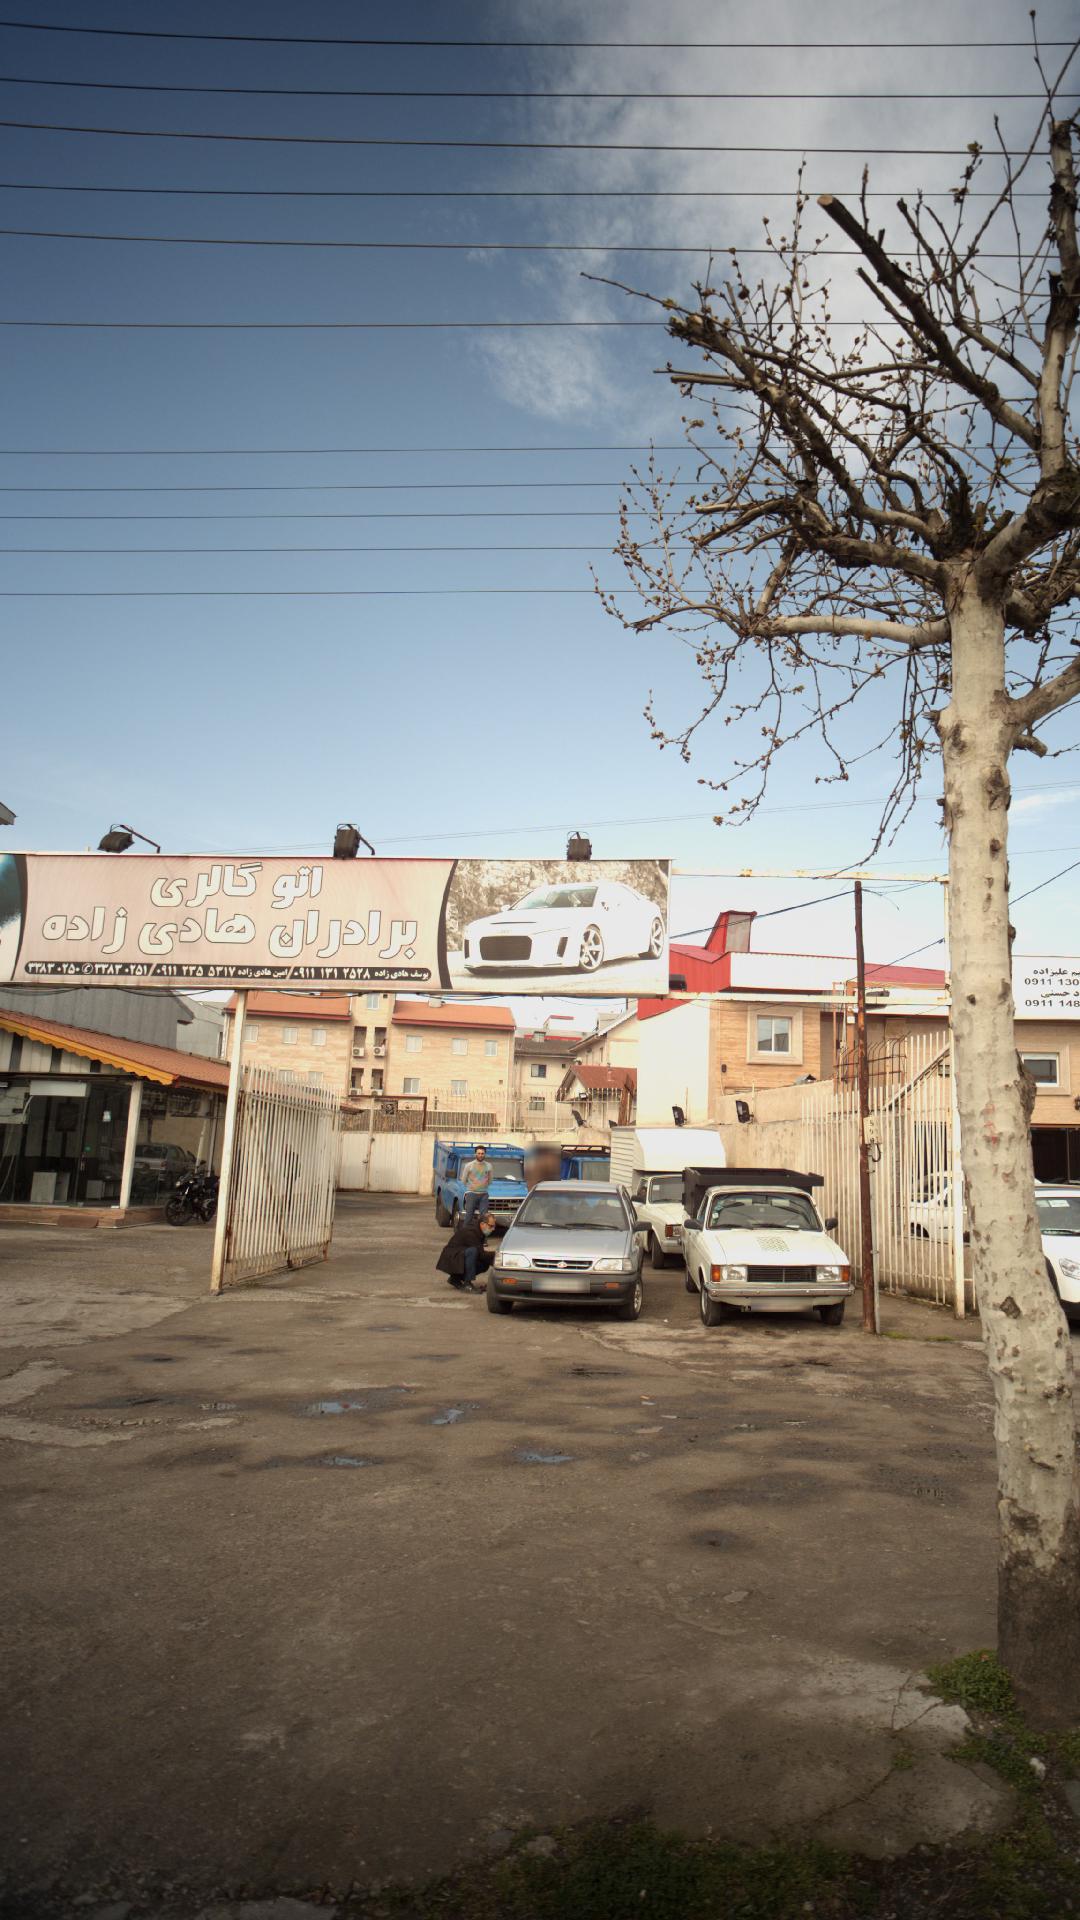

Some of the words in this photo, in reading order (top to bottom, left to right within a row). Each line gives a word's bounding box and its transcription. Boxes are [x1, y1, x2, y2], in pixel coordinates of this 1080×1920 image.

[150, 862, 263, 907] گالری
[271, 865, 324, 909] اتو
[42, 906, 128, 954] زاده
[138, 908, 256, 955] هادی
[268, 910, 418, 960] برادران
[253, 968, 272, 977] هادی
[390, 969, 409, 979] هادی
[410, 969, 429, 980] یوسف
[1024, 978, 1052, 986] 0911
[1025, 999, 1053, 1007] 0911
